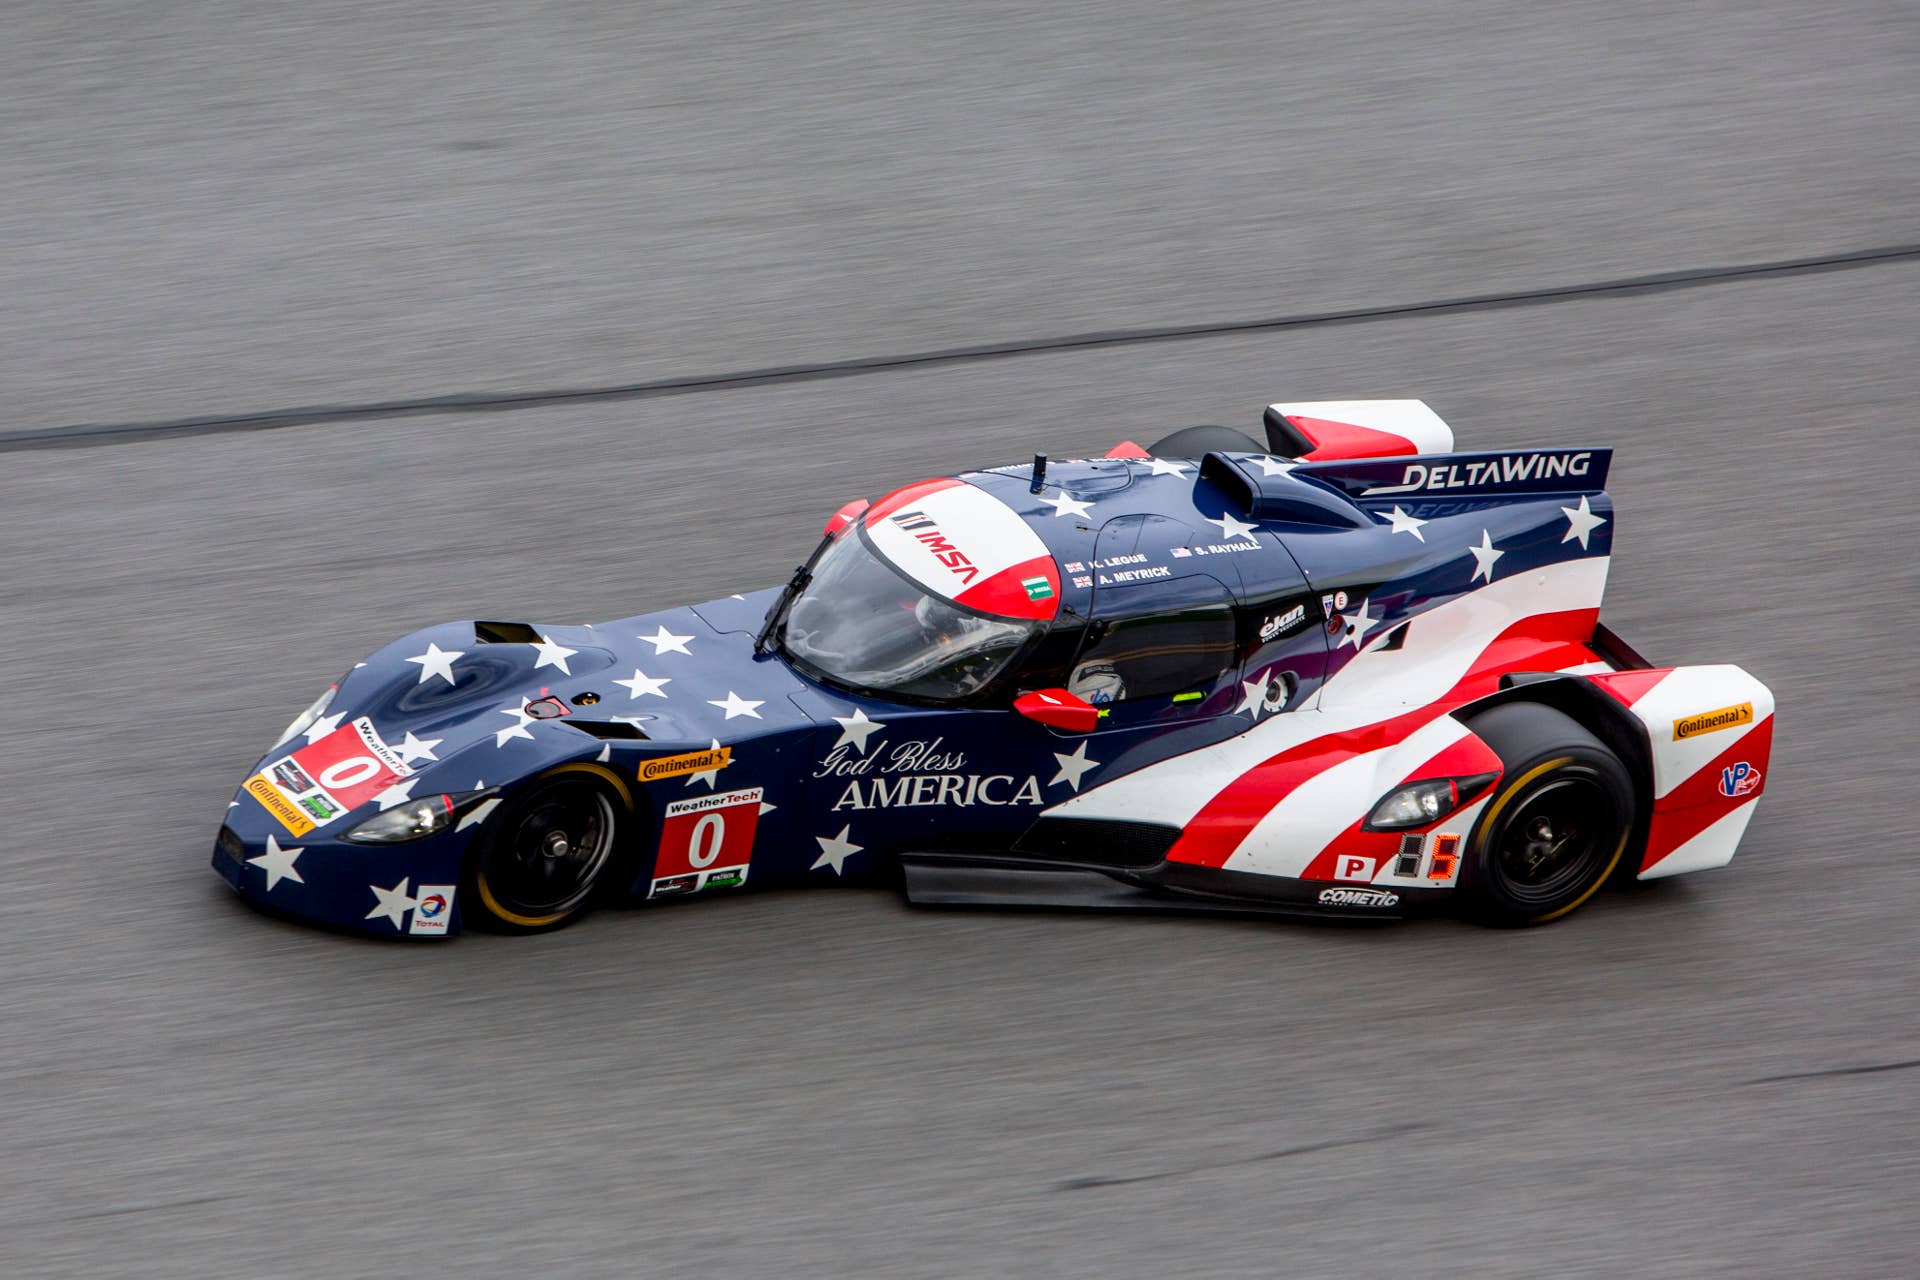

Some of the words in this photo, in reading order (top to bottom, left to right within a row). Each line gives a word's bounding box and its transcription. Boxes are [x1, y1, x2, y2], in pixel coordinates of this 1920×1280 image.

[1361, 452, 1592, 495] DELTAWING
[914, 531, 979, 585] IMSA
[1194, 546, 1208, 556] S.
[1100, 575, 1114, 585] A.
[1115, 566, 1172, 582] MEYRICK
[1677, 708, 1739, 737] Continental
[320, 756, 381, 788] 0
[643, 753, 714, 779] Continental
[813, 740, 888, 778] God
[880, 737, 968, 774] Bless
[831, 775, 1044, 811] AMERICA
[1722, 762, 1750, 796] VP
[249, 779, 302, 824] Continental
[671, 791, 759, 814] WeatherTech
[688, 813, 725, 869] 0
[1319, 889, 1399, 906] COMETIC
